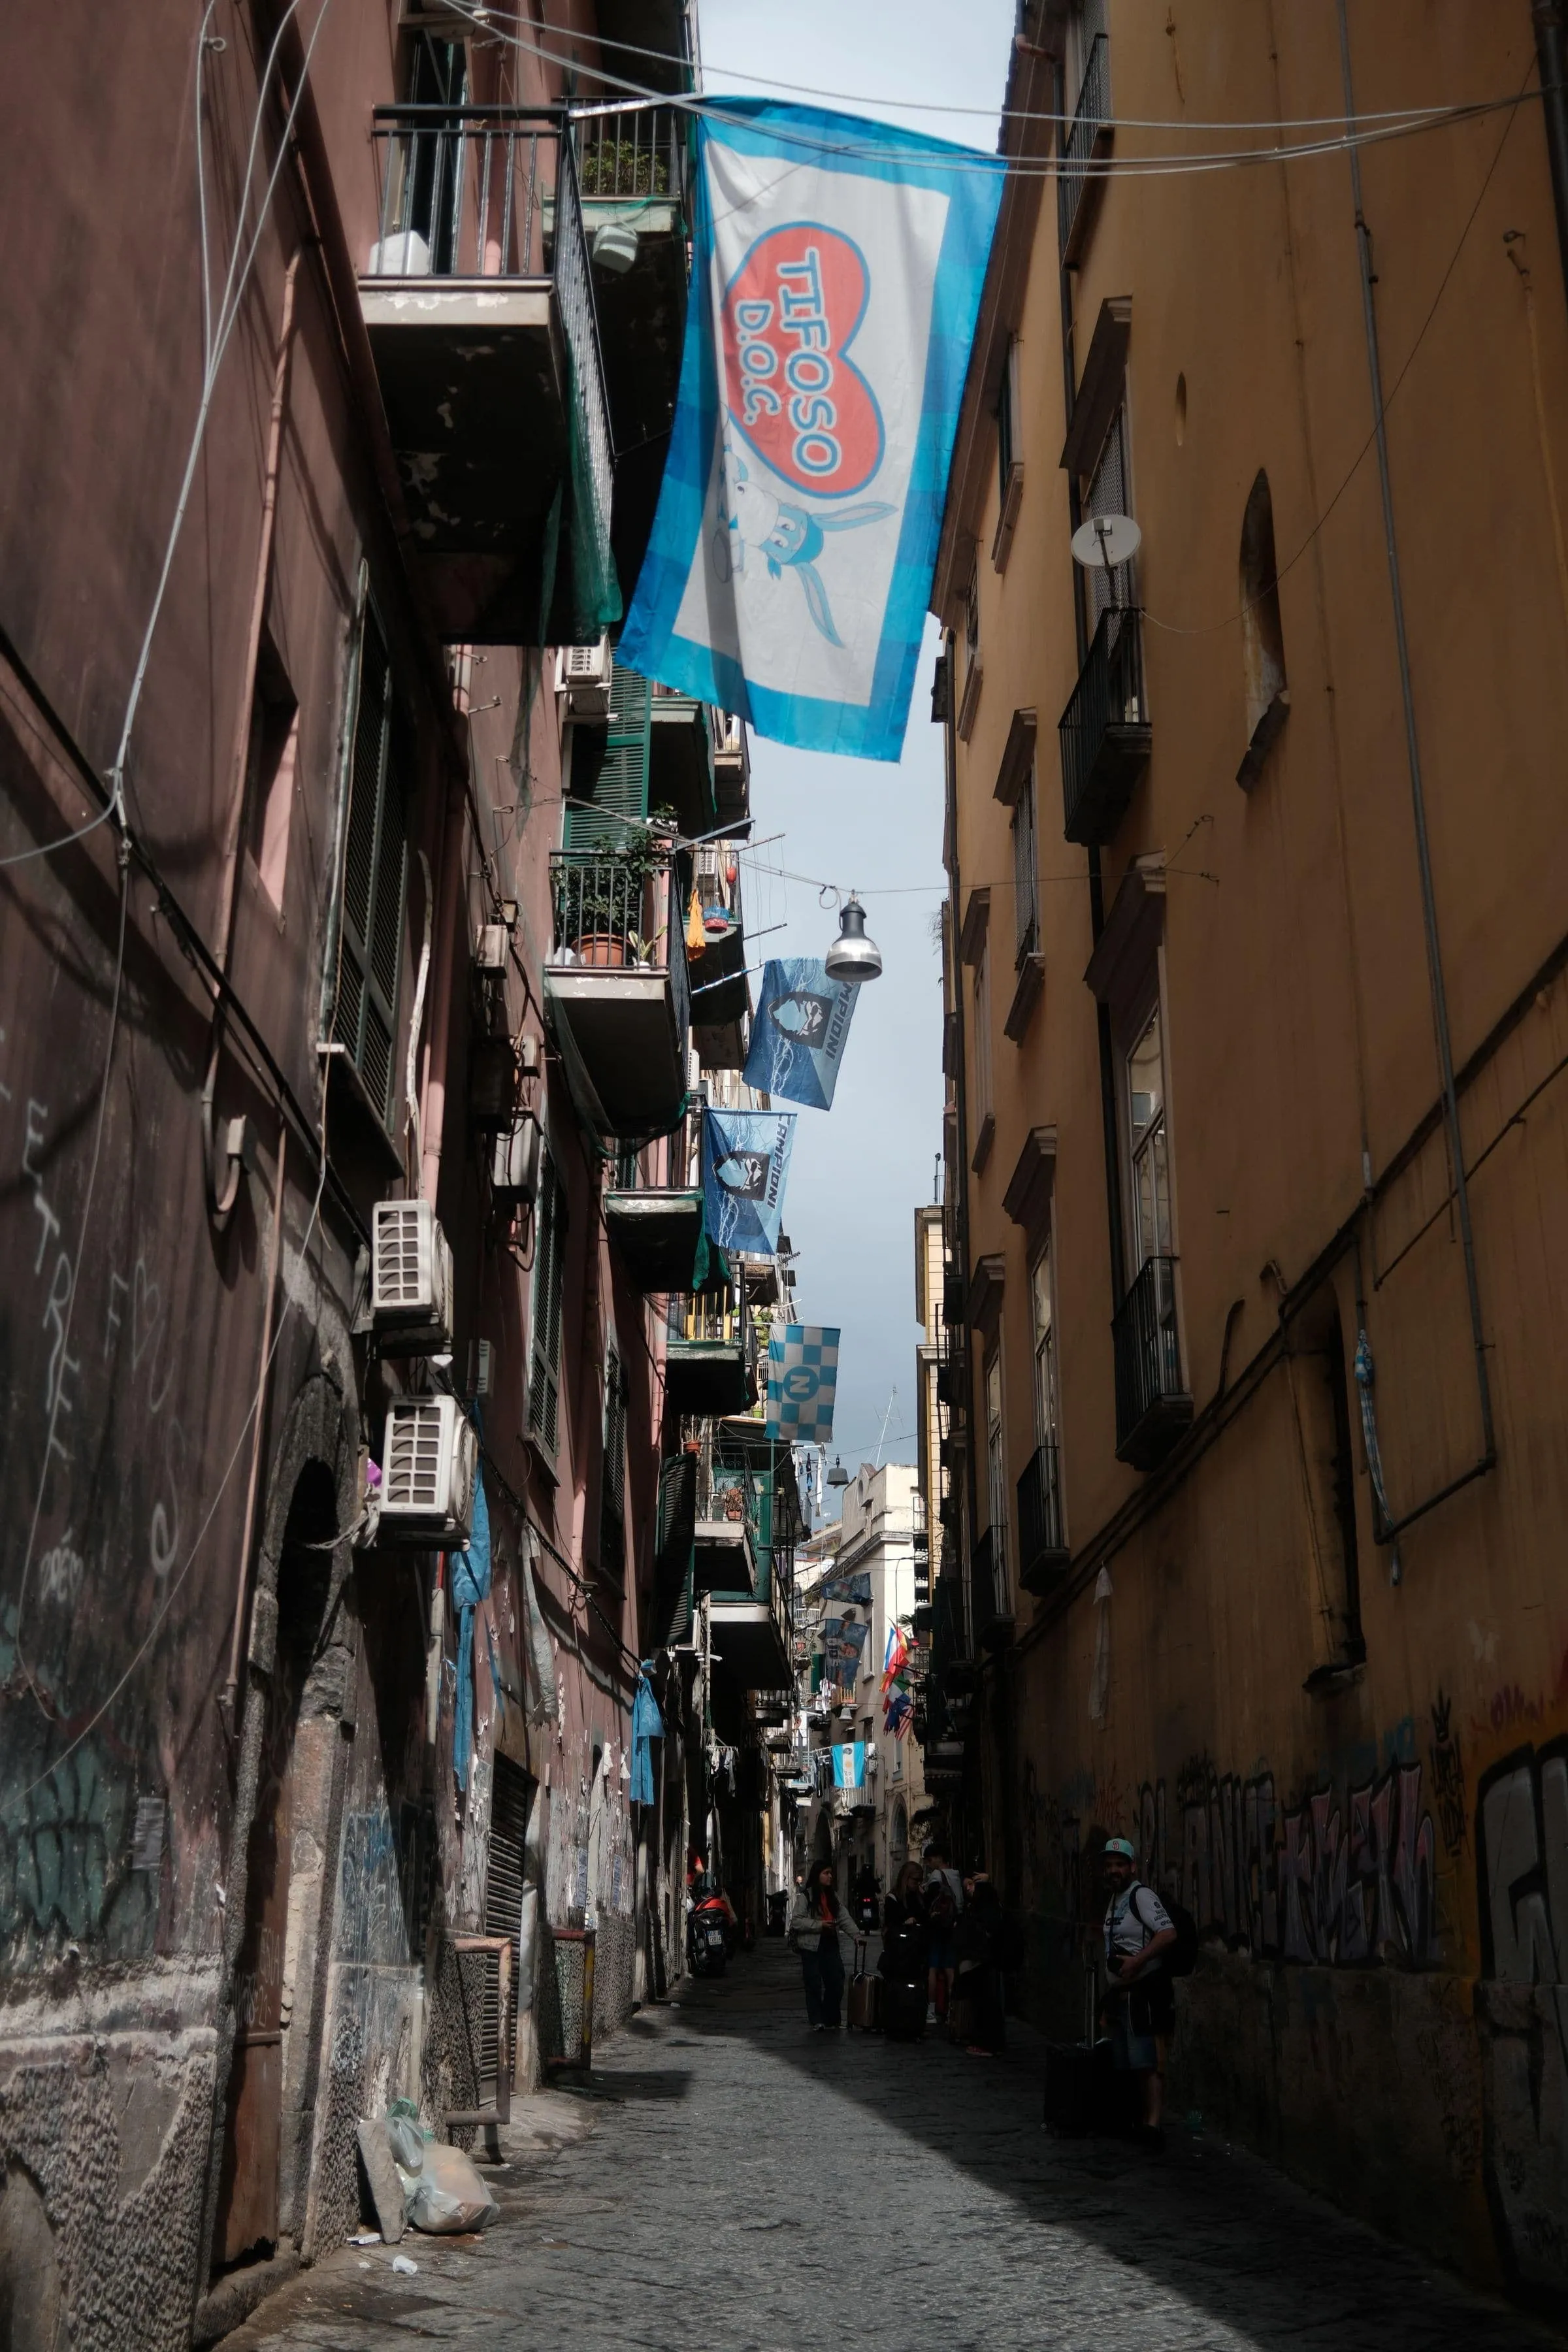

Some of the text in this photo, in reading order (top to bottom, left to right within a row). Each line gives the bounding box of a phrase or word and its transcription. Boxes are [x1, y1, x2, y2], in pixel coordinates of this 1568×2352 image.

[736, 300, 780, 425] D.O.C.
[777, 248, 841, 476] TIFOSO
[825, 981, 854, 1061] MPIONI
[790, 1375, 810, 1394] N
